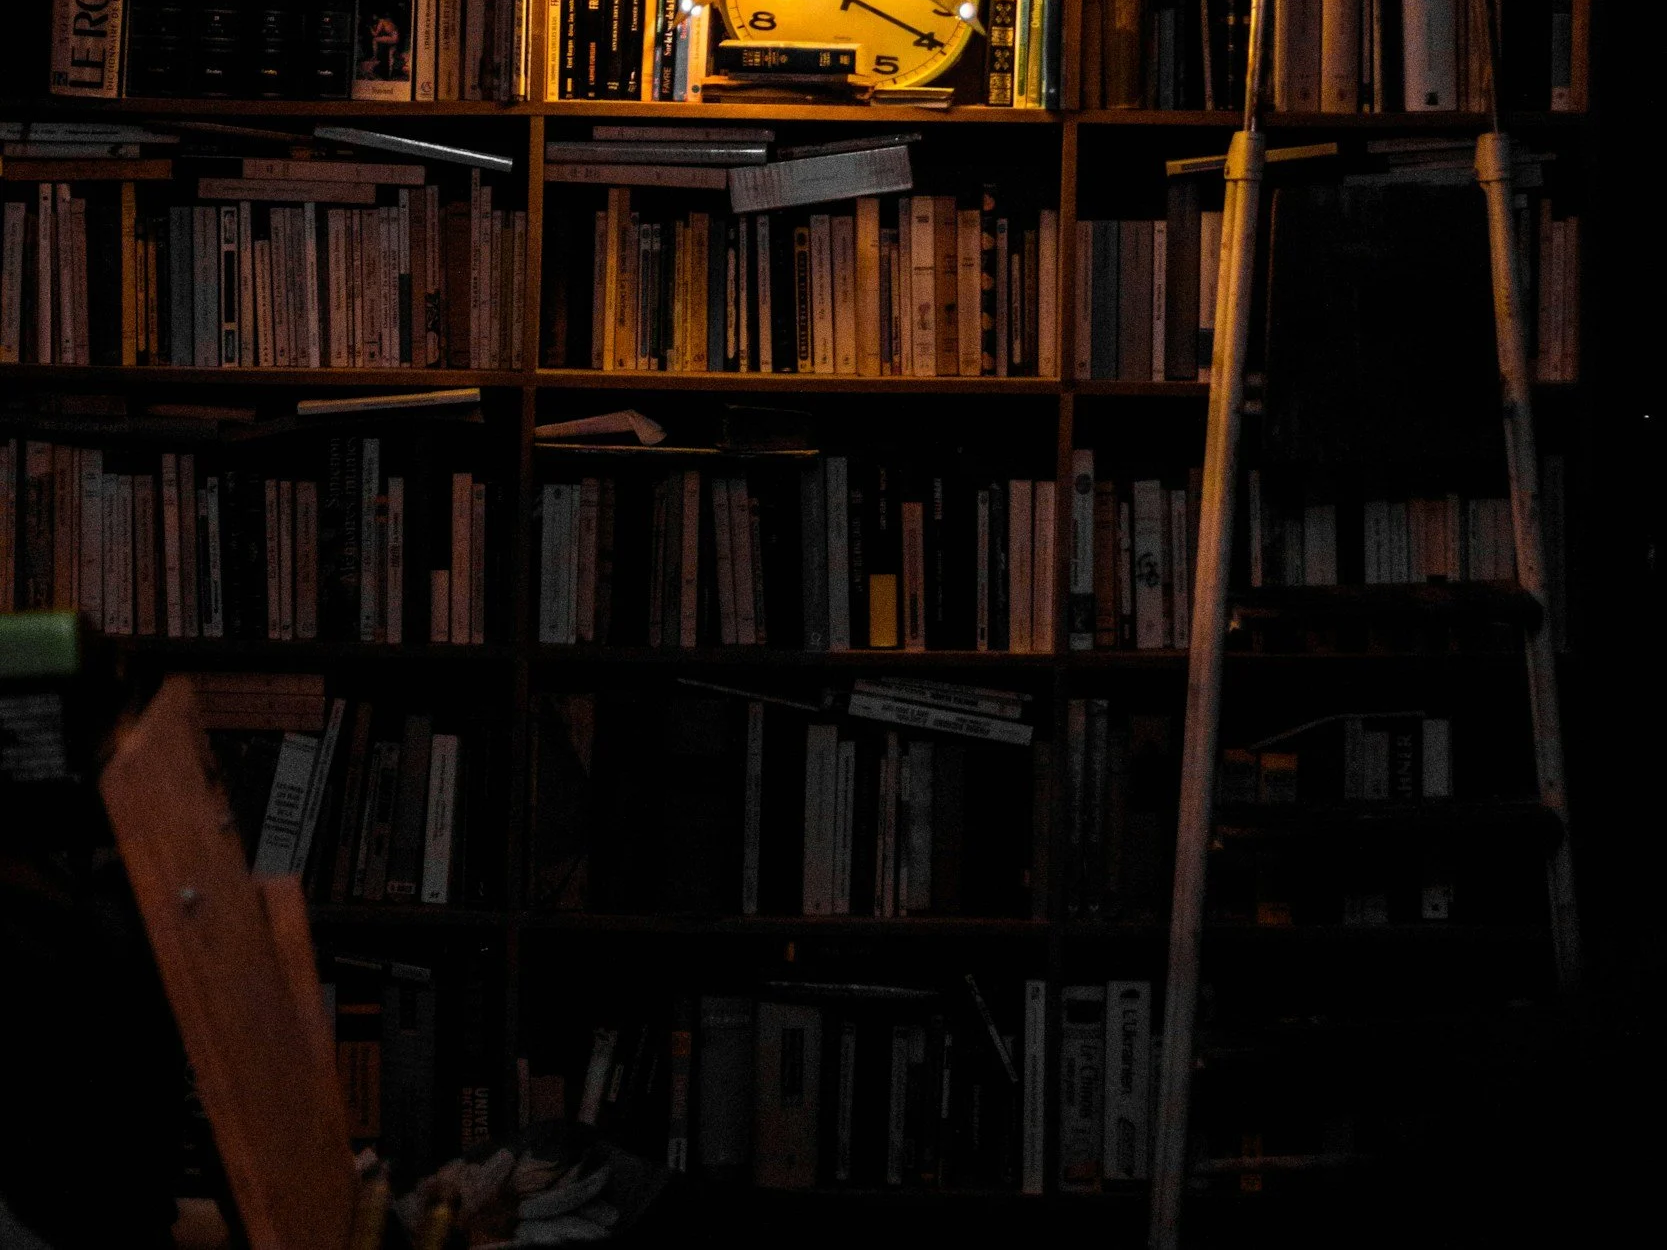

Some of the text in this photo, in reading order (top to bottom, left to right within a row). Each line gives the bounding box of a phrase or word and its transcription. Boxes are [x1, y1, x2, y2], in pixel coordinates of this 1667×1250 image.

[111, 7, 119, 18] DE
[665, 11, 674, 20] de
[749, 11, 777, 31] 8
[663, 43, 672, 56] Sur
[913, 32, 944, 51] 4
[69, 47, 106, 89] LE
[107, 23, 118, 90] DICTIONNAIRE
[872, 55, 900, 75] 5
[662, 67, 671, 93] FAVRE
[324, 437, 342, 508] Simenon
[1120, 1009, 1137, 1094] L'Ukrainien
[1080, 1065, 1098, 1120] Chinois
